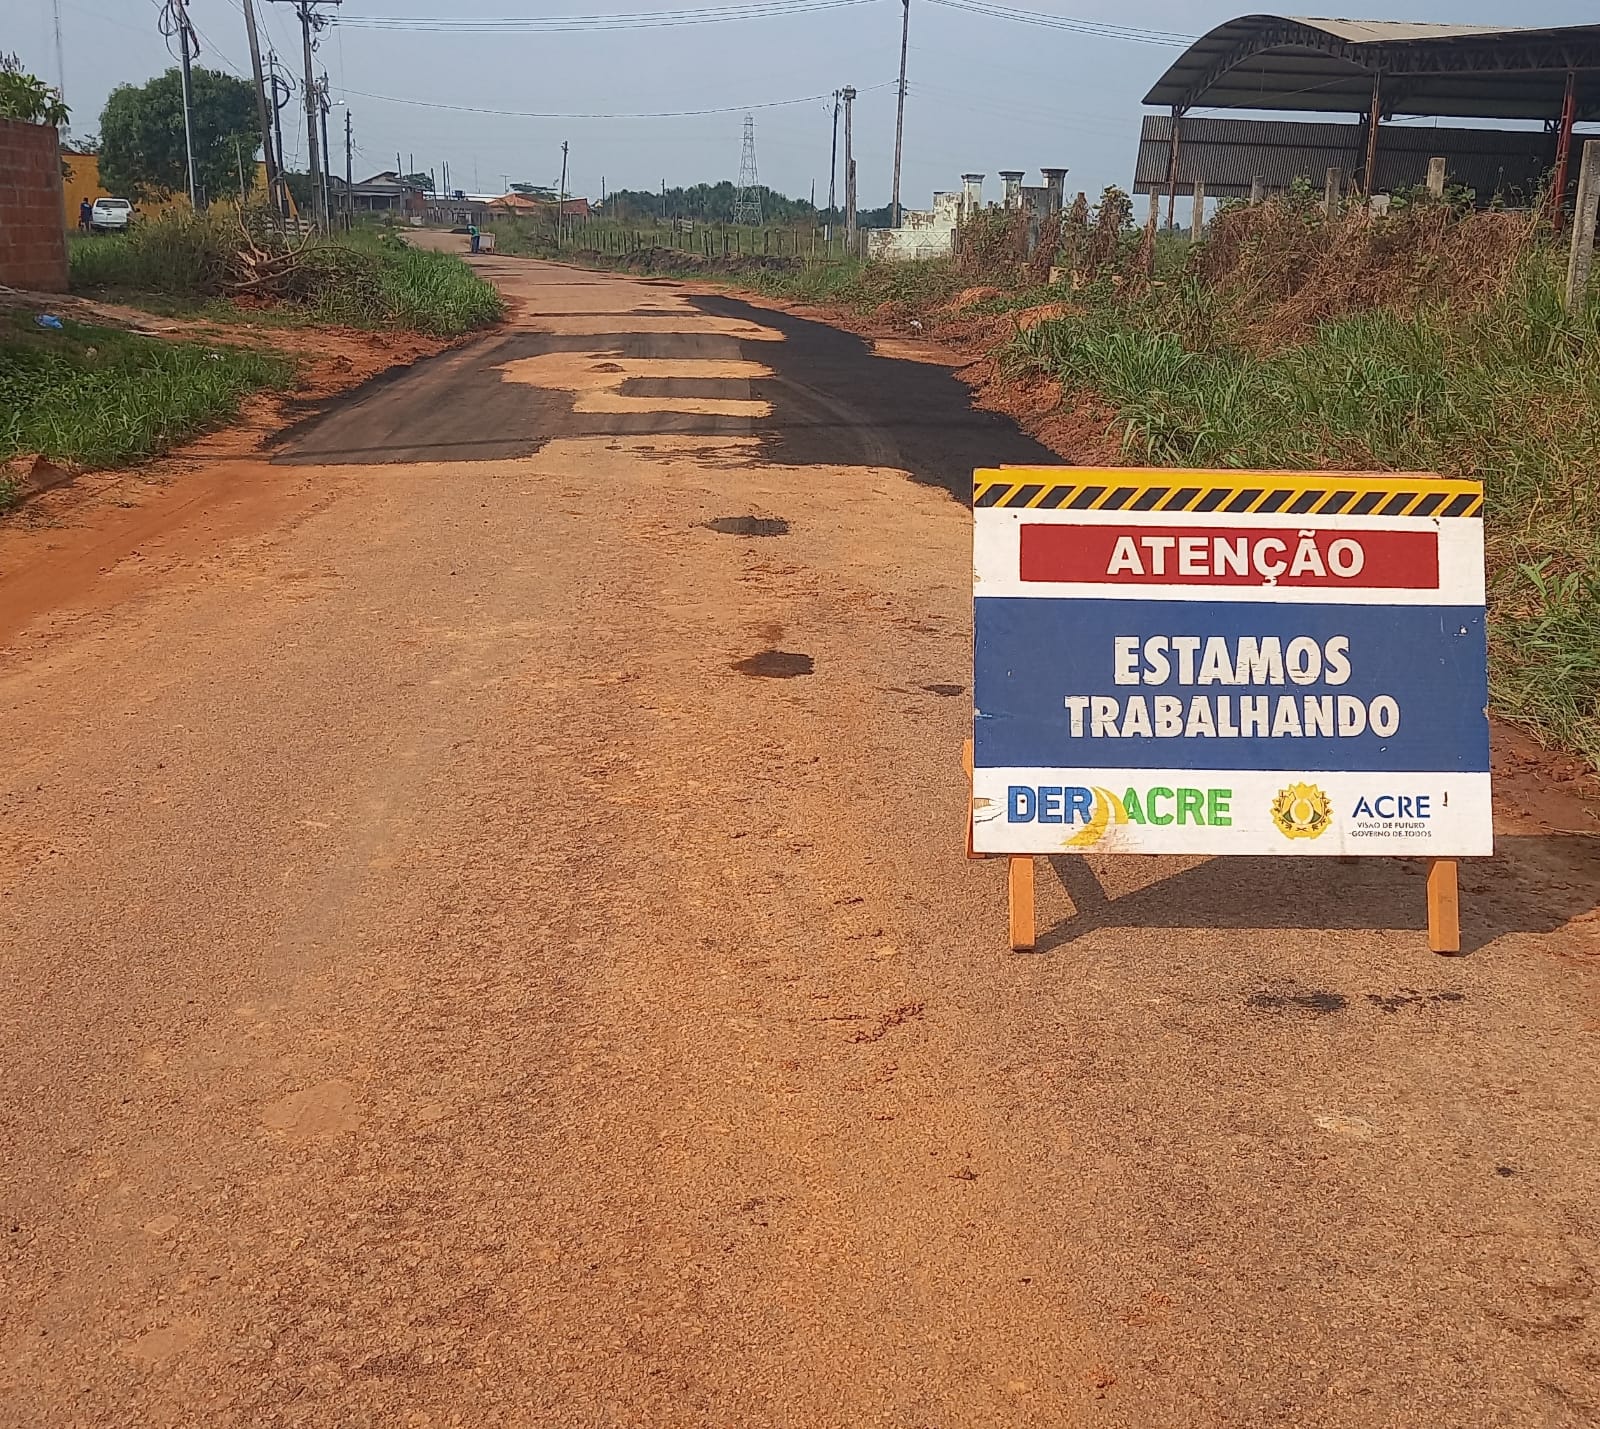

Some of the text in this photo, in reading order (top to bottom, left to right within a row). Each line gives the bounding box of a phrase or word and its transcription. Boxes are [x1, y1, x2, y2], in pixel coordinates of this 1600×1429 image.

[1106, 529, 1365, 587] ATENÇÃO
[1113, 635, 1352, 686] ESTAMOS
[1064, 694, 1400, 738] TRABALHANDO
[1007, 785, 1233, 826] DER ACRE
[1351, 795, 1431, 819] ACRE
[1351, 830, 1432, 838] GOVERNO DE TODOS
